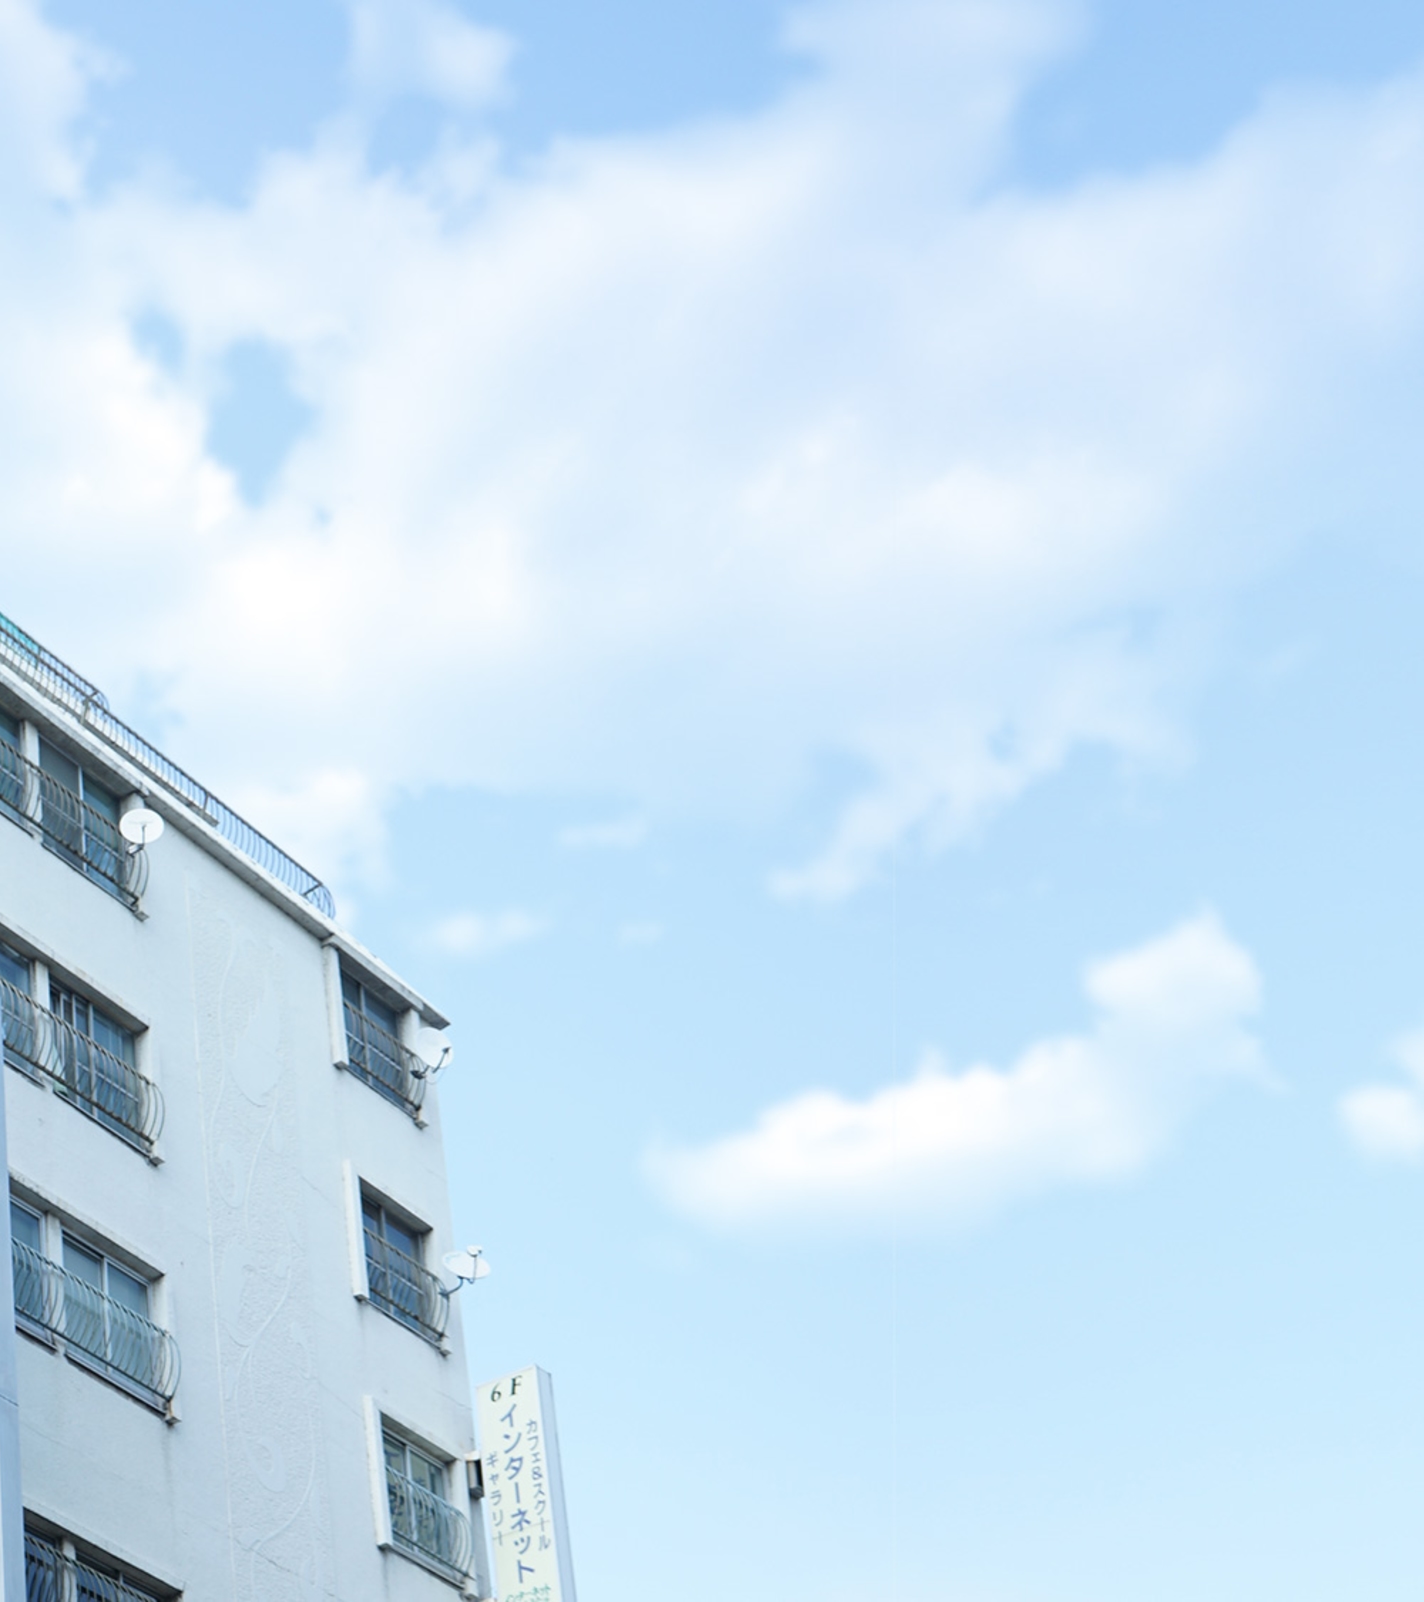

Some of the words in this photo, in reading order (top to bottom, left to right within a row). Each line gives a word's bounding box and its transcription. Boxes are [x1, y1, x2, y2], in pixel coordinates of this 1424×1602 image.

[485, 1451, 504, 1547] ギャラリー
[500, 1403, 536, 1585] インターネット
